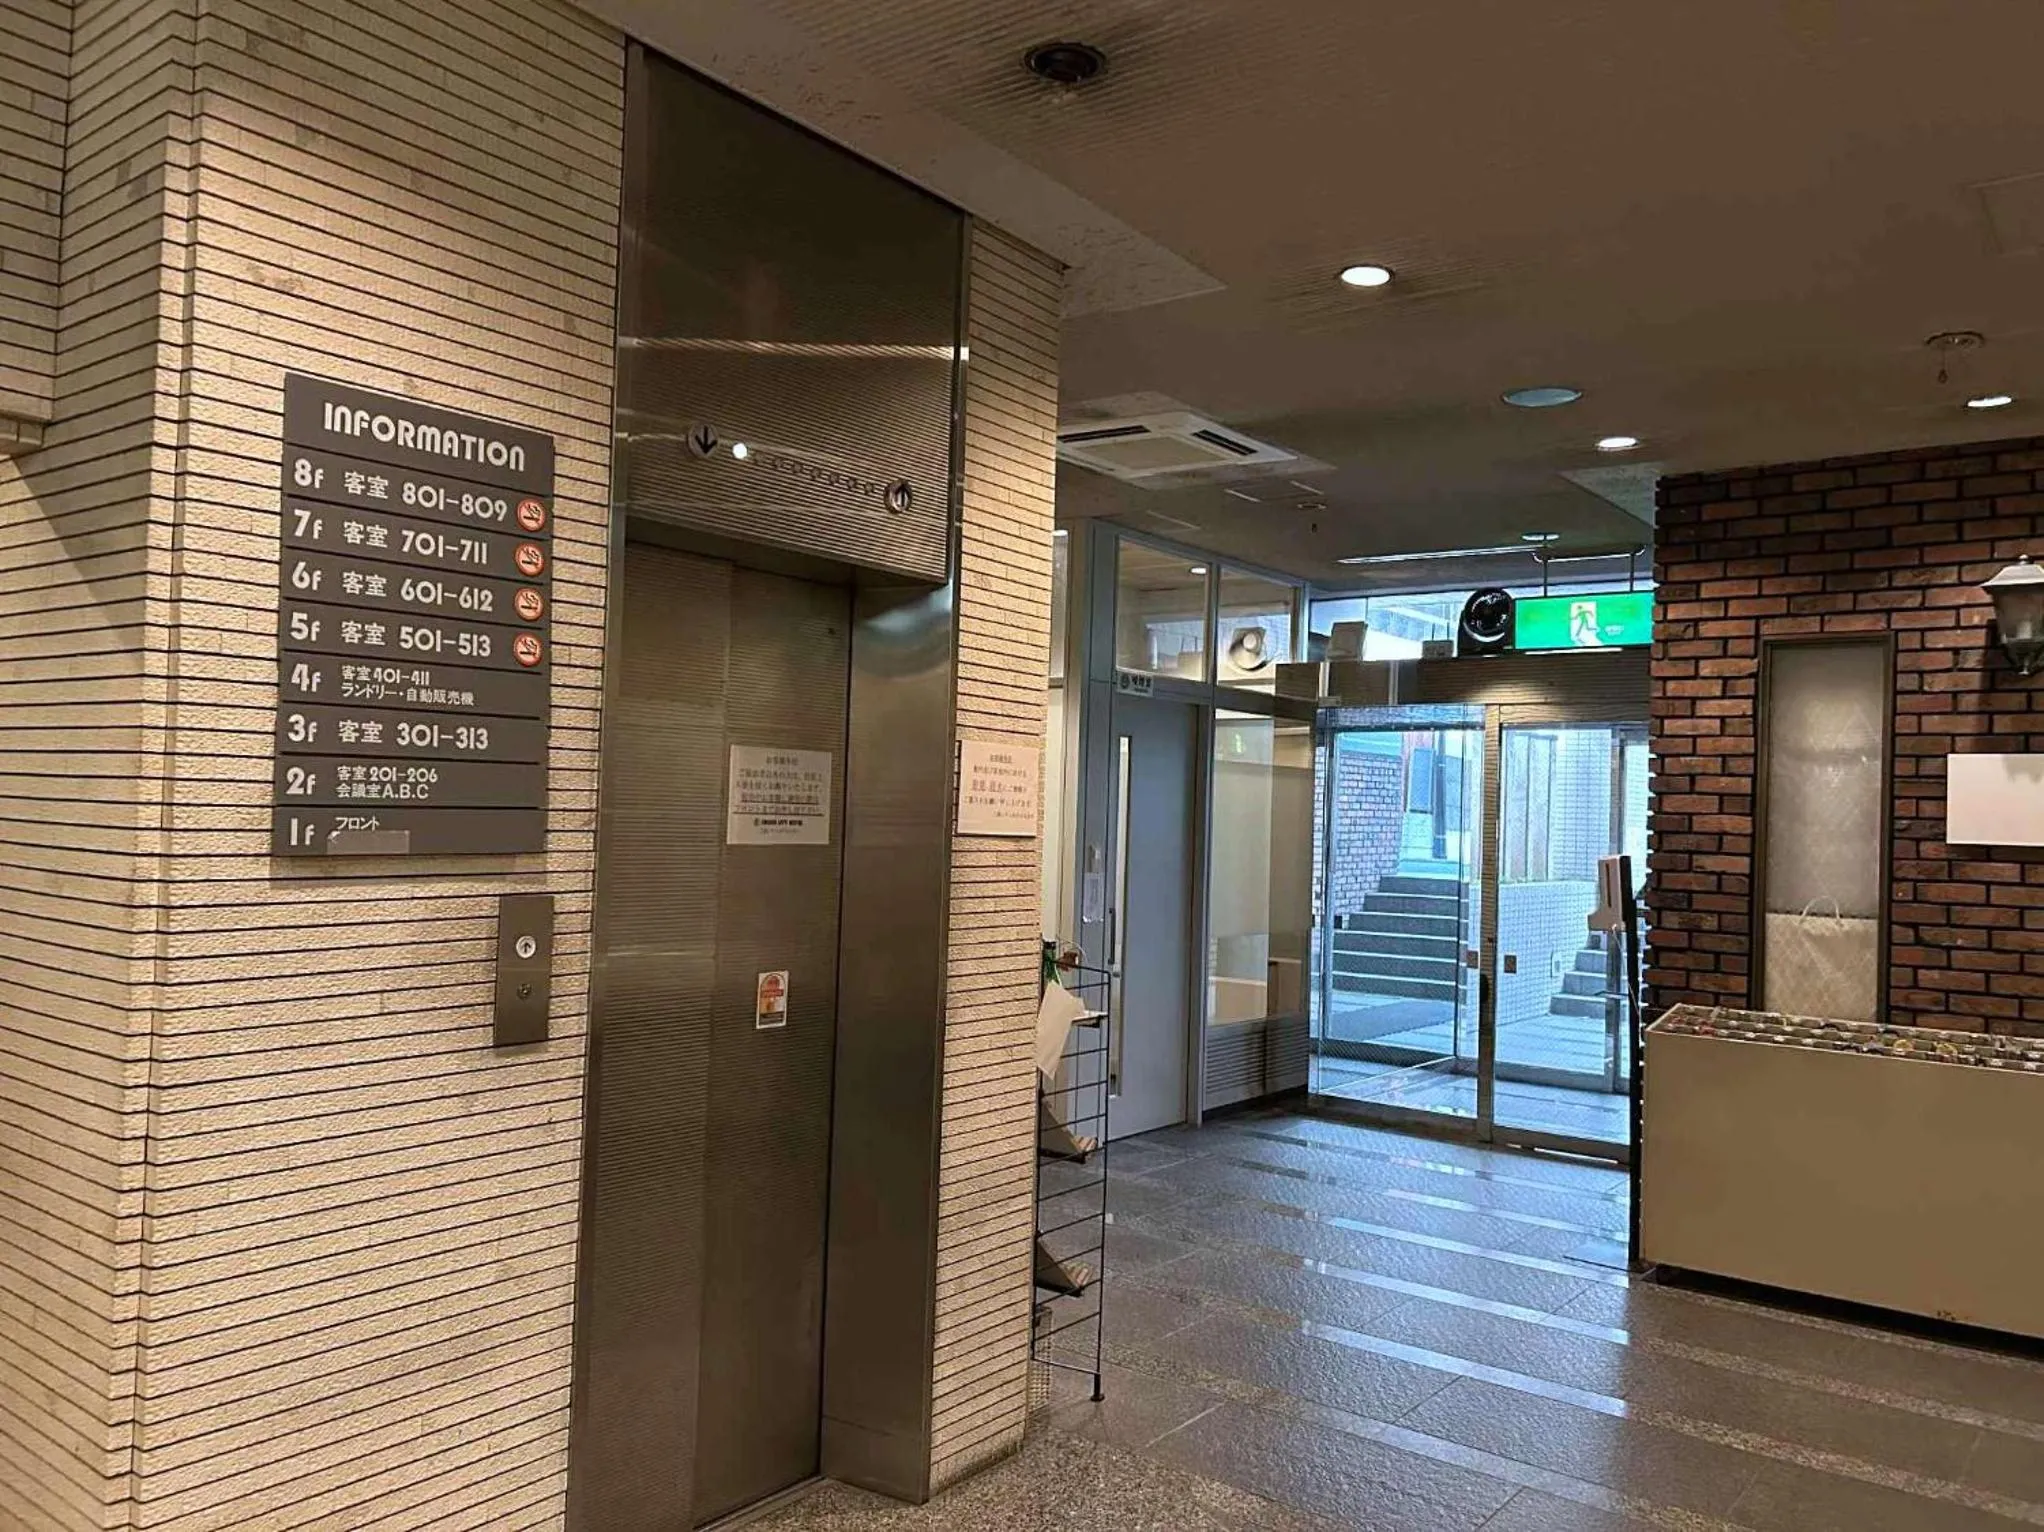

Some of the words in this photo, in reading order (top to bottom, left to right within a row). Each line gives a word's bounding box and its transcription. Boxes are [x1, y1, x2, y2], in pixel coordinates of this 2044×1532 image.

[323, 402, 525, 472] INFORMATION
[344, 471, 388, 499] 客室
[403, 482, 507, 521] 801-809
[344, 521, 388, 548] 客室
[402, 530, 487, 564] 701-711
[343, 571, 386, 597] 客室
[401, 579, 492, 611] 601-612
[341, 621, 385, 645] 客室
[400, 626, 490, 656] 501-513
[339, 720, 383, 743] 客室
[397, 723, 488, 749] 301-313
[336, 816, 379, 831] フロント
